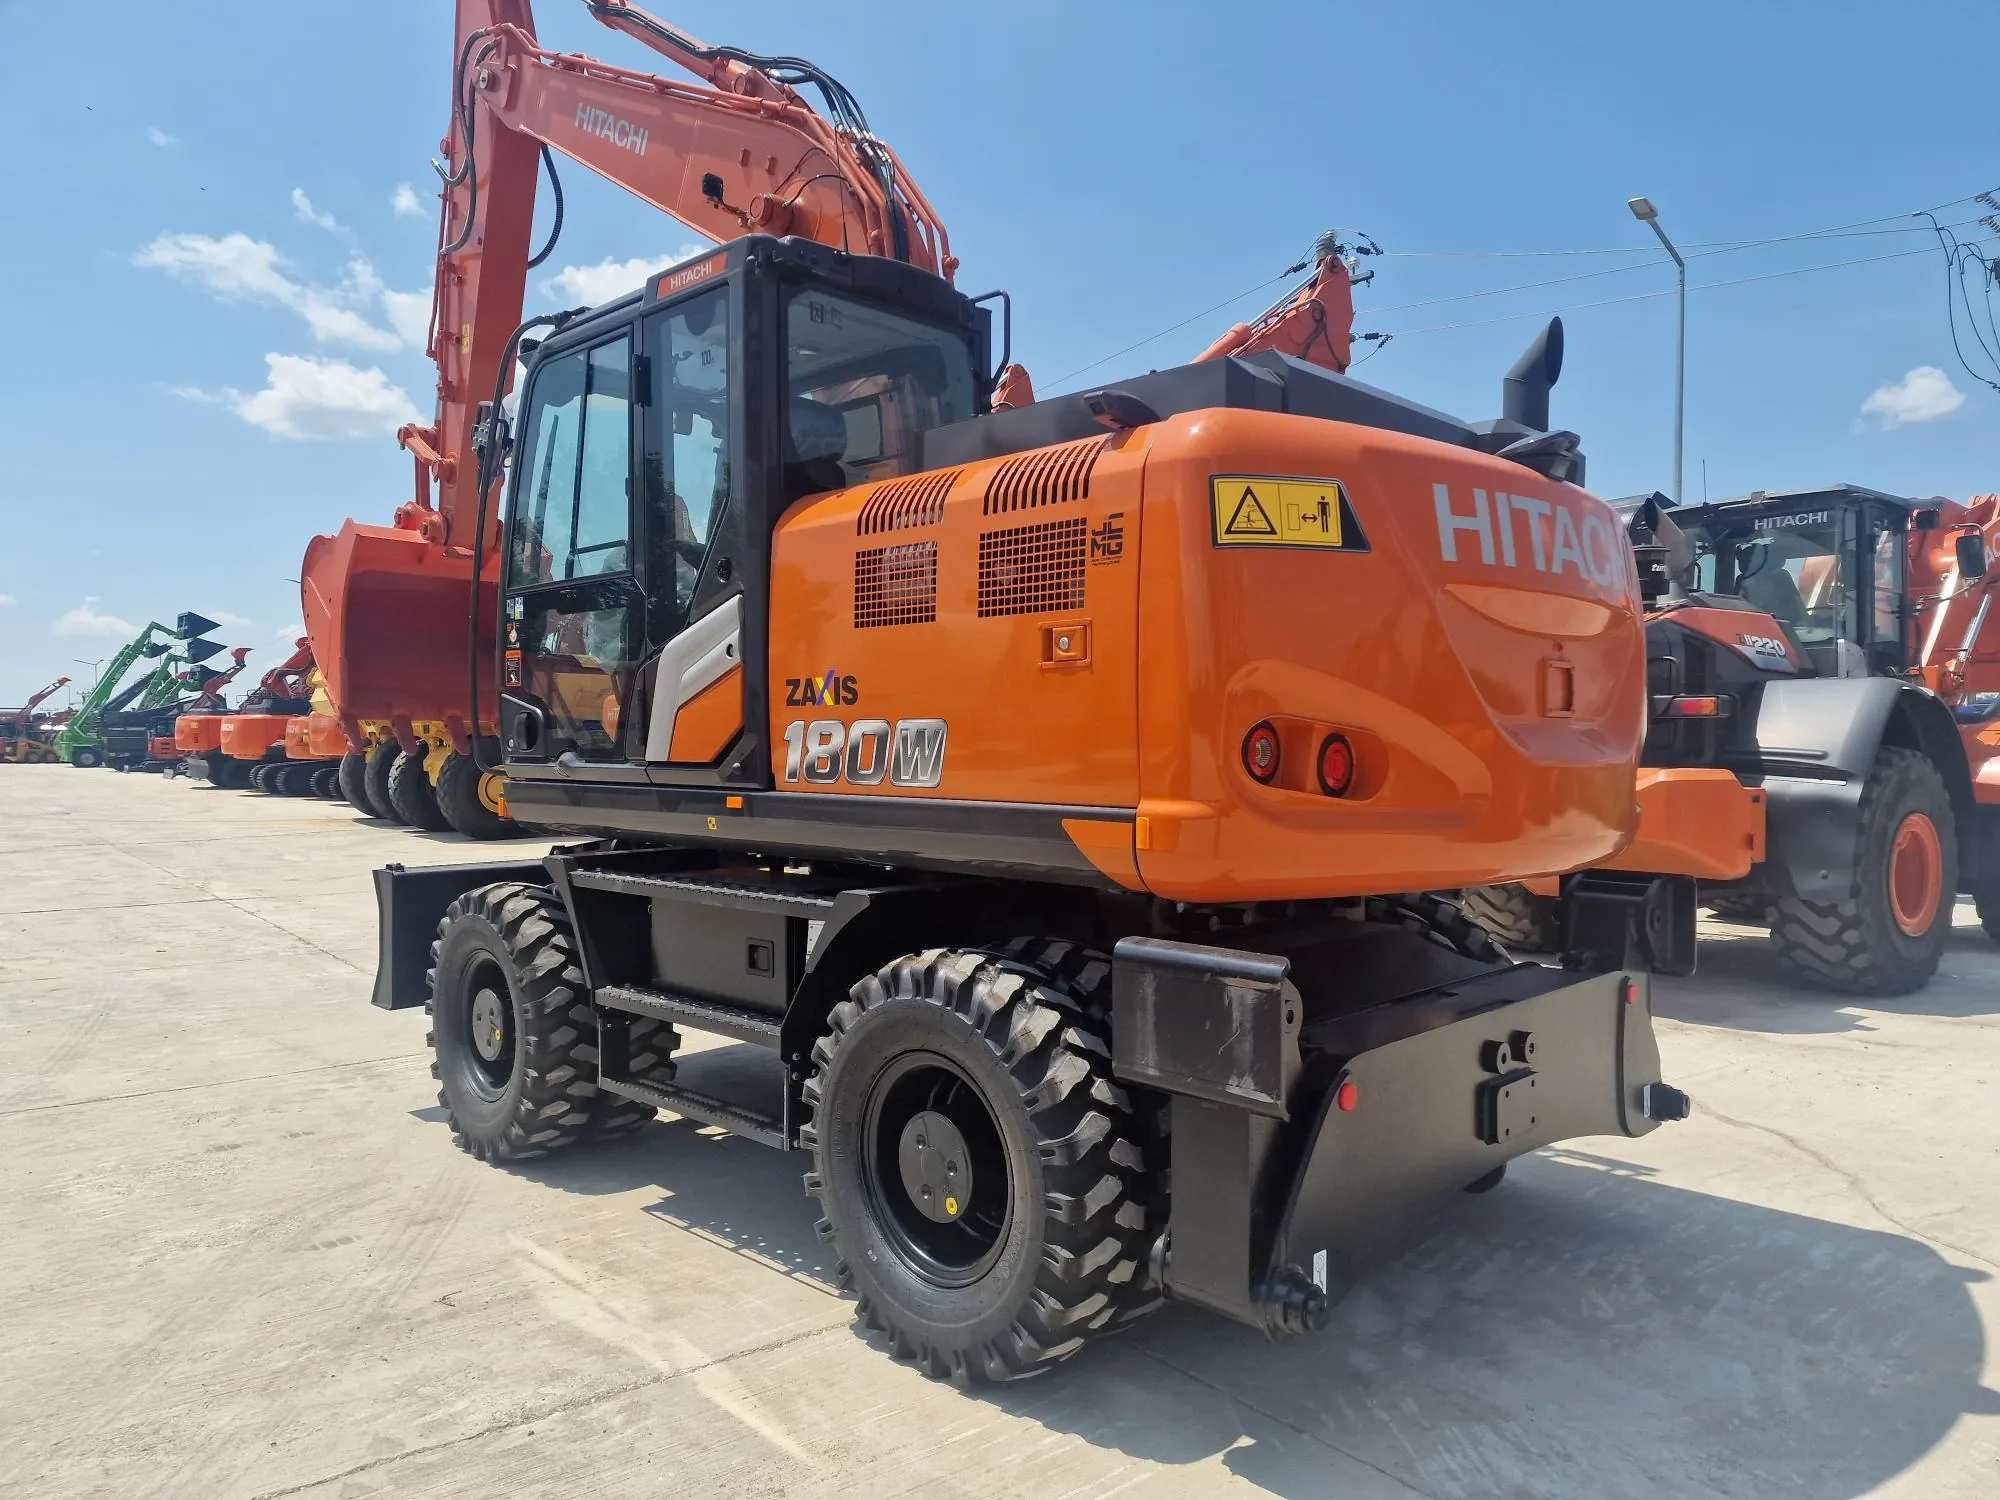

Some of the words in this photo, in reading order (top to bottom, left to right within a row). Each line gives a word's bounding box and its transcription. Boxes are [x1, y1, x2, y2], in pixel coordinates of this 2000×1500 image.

[575, 102, 649, 157] HITACHI
[670, 260, 712, 289] HITACHI
[1754, 511, 1828, 531] HITACHI
[786, 669, 858, 706] ZAXIS
[783, 718, 948, 788] 180W
